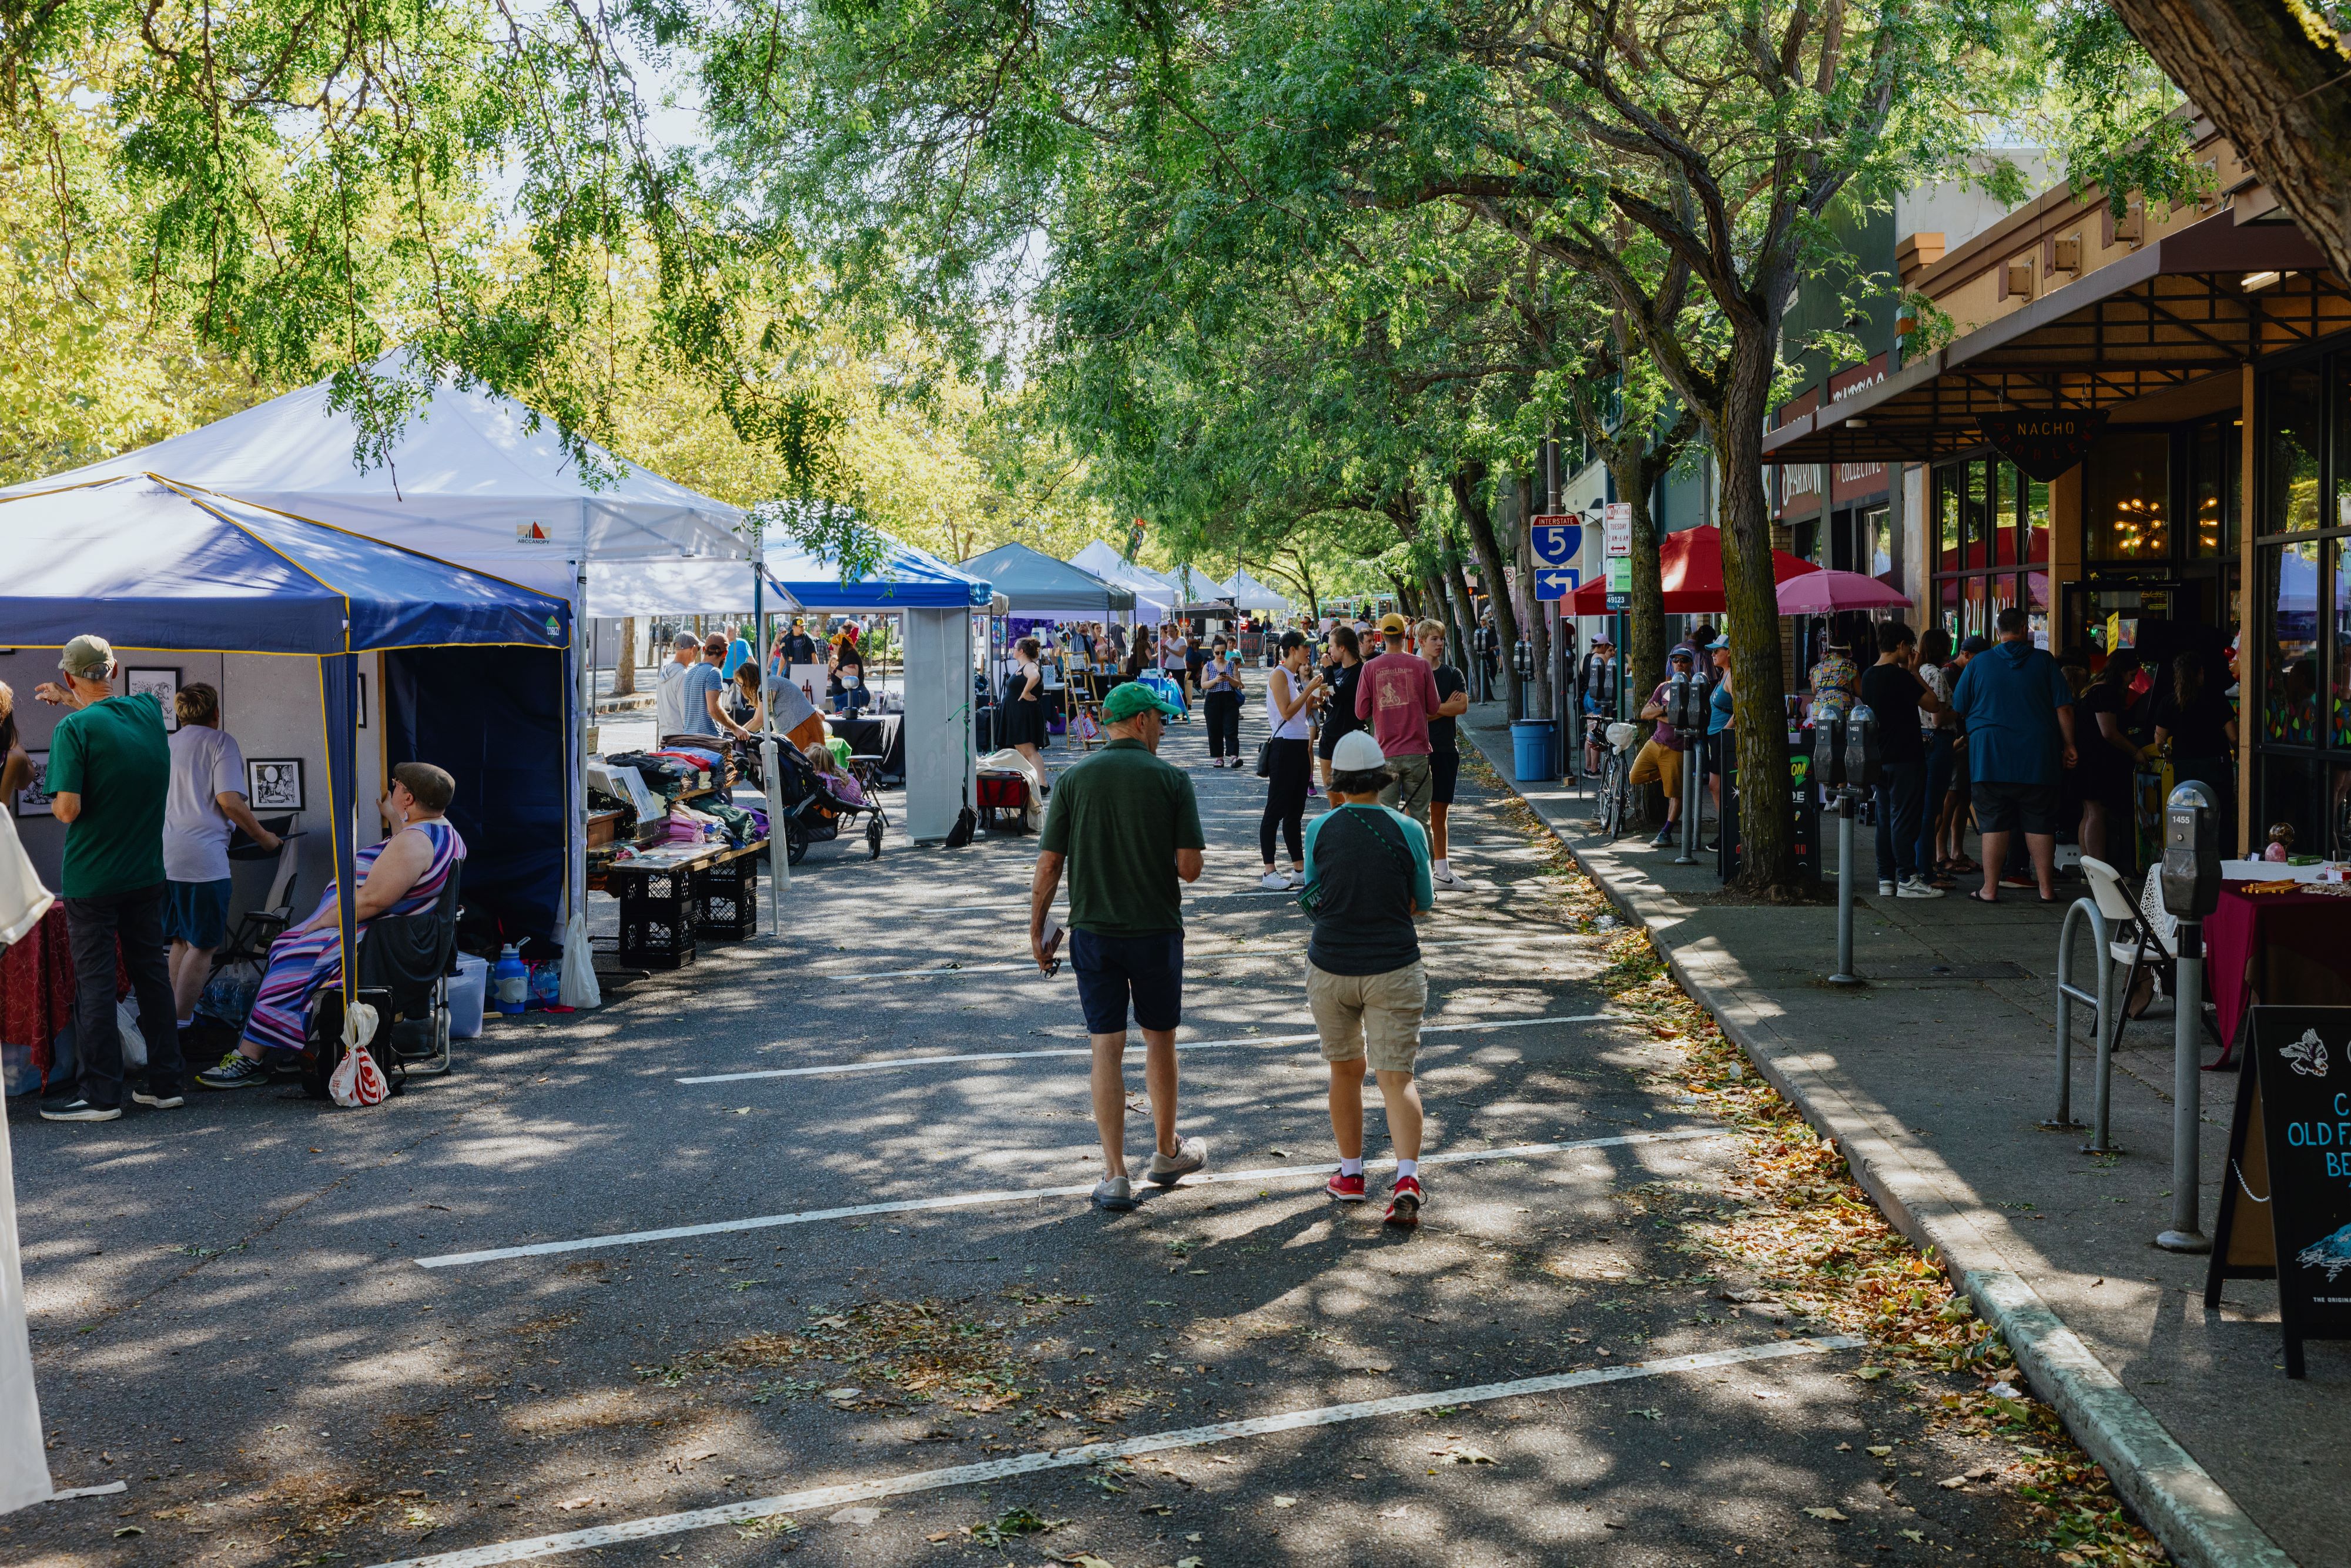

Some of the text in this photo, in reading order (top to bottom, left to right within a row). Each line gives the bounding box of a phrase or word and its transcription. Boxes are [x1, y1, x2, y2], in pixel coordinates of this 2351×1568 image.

[2017, 421, 2075, 436] NACHO
[1782, 463, 1821, 507] SPARROW
[1607, 507, 1614, 518] NO
[1548, 528, 1566, 556] 5
[2172, 816, 2190, 824] 1455
[2288, 1122, 2351, 1146] OLD F
